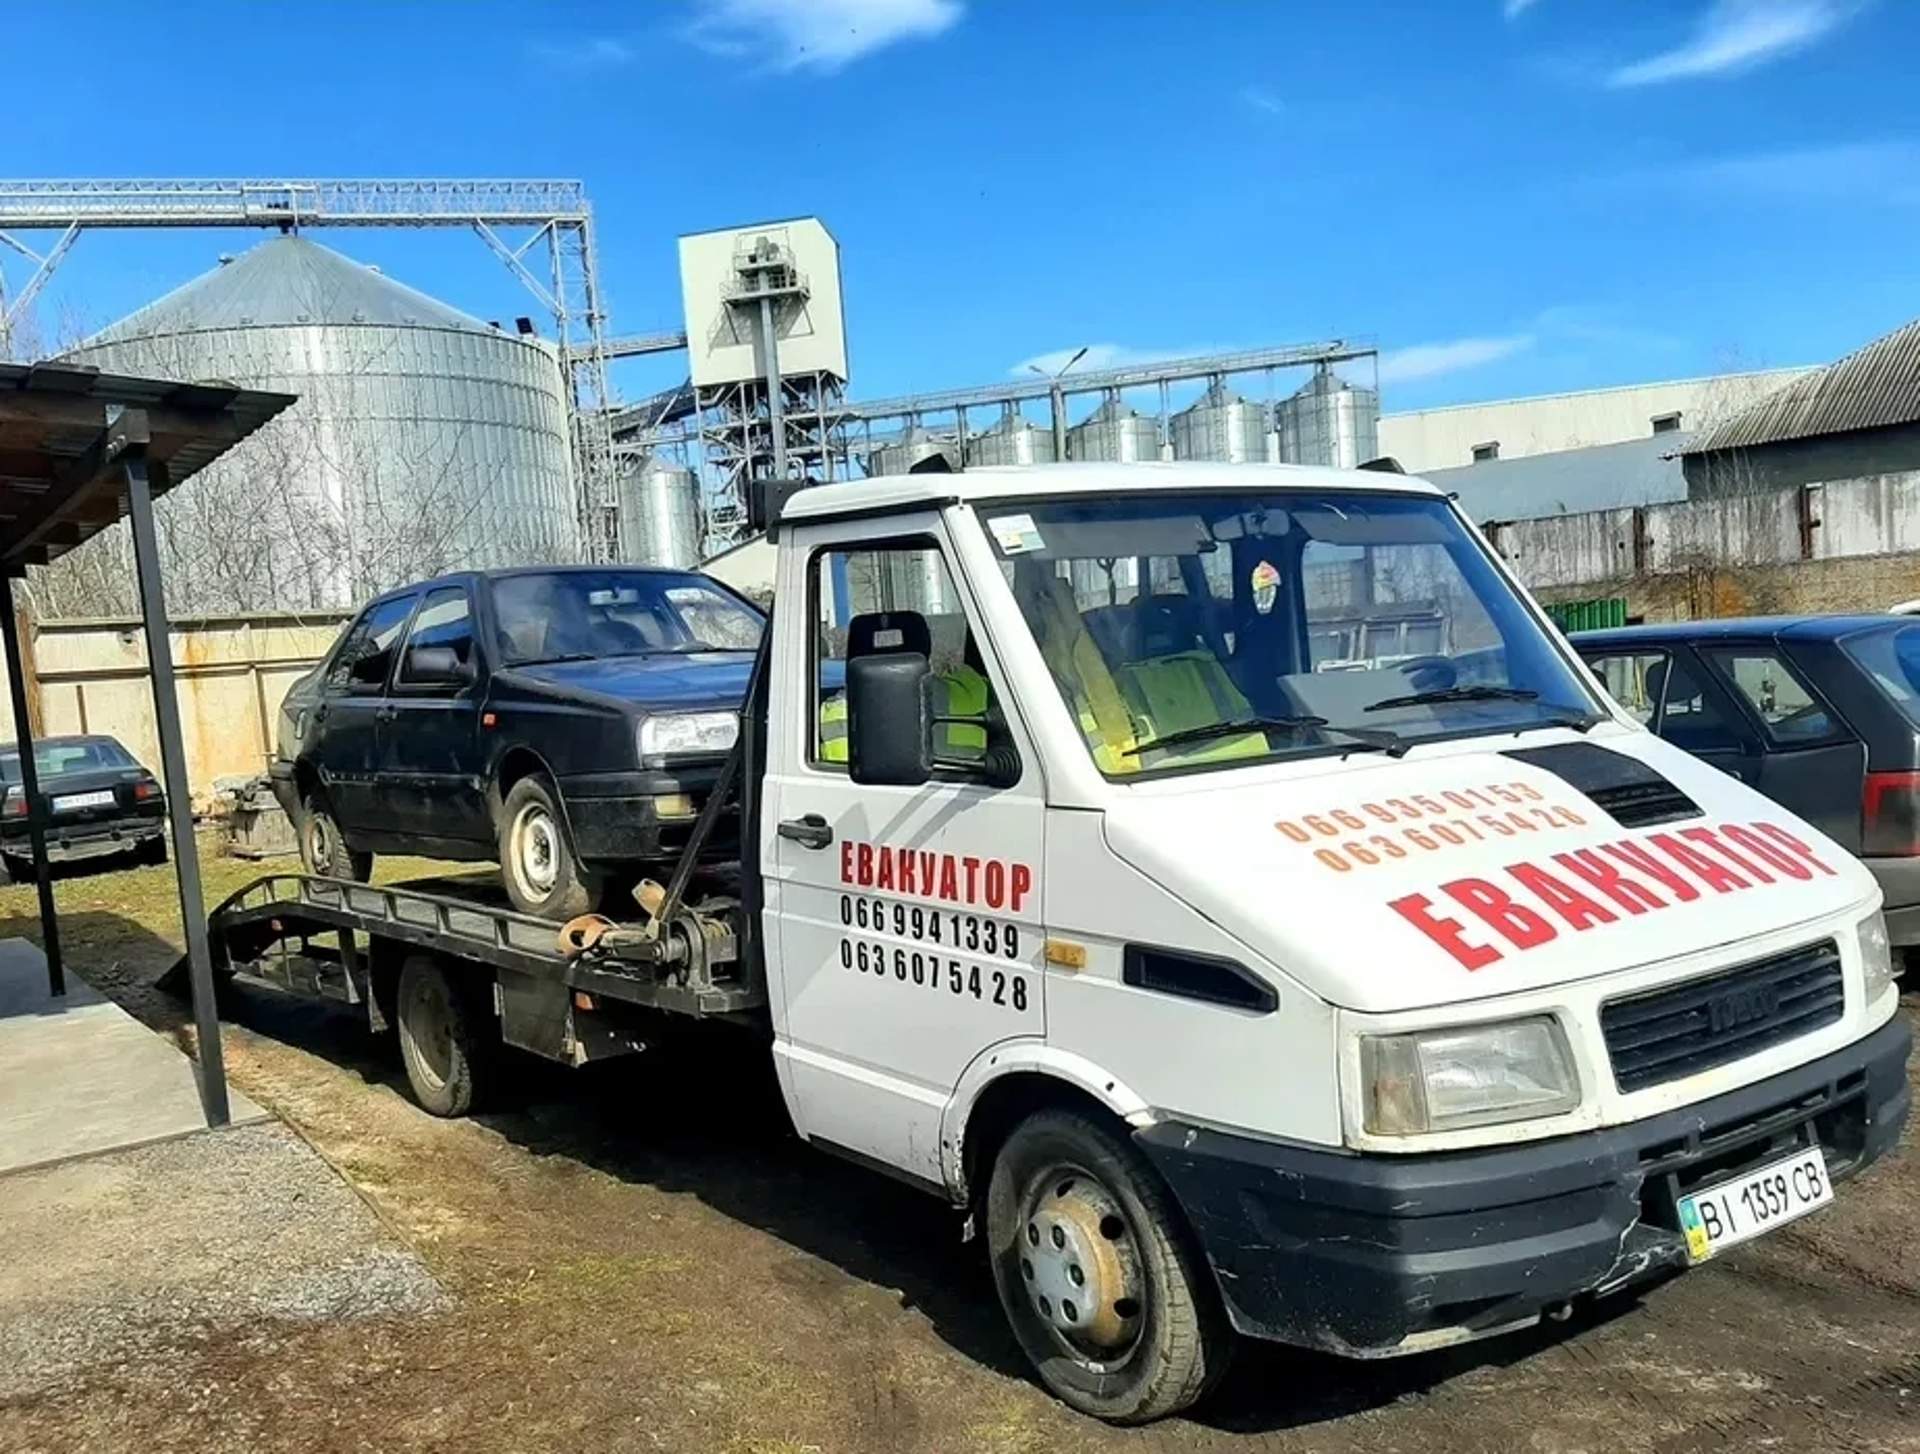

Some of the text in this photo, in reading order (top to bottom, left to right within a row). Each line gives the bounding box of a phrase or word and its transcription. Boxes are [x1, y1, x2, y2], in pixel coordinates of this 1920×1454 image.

[1274, 809, 1366, 842] 066
[1360, 794, 1446, 823] 935
[1313, 835, 1407, 871] 063
[1402, 819, 1485, 851] 607
[841, 841, 1030, 912] ЕВАКУАТОР
[1386, 822, 1838, 972] ЕВАКУАТОР
[841, 894, 884, 931] 066
[893, 903, 942, 943] 994
[841, 938, 885, 976] 063
[894, 949, 940, 988] 607
[1741, 1174, 1789, 1224] 1359
